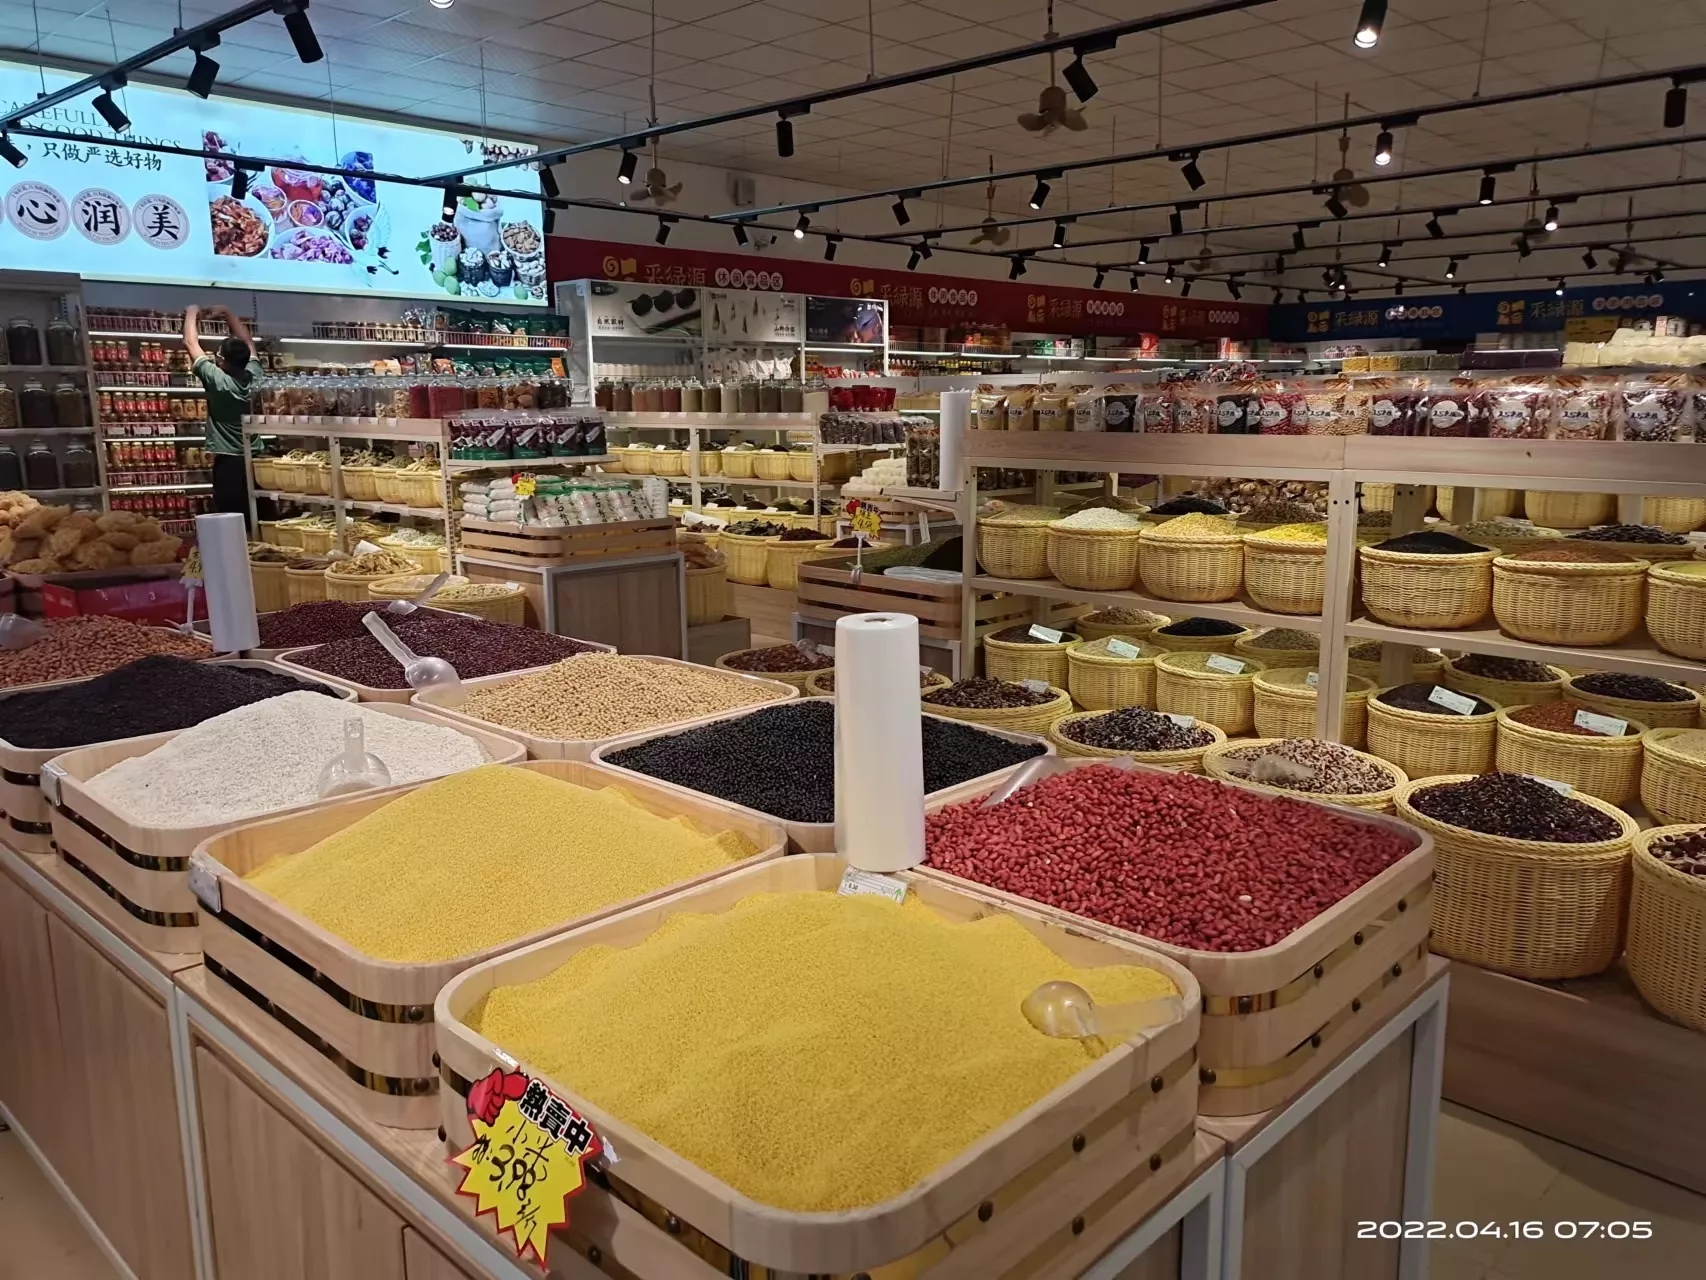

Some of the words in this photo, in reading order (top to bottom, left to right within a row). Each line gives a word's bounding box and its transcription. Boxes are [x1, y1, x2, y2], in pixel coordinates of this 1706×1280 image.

[716, 269, 783, 290] 休闲食品区
[519, 1082, 593, 1154] 熱賣中
